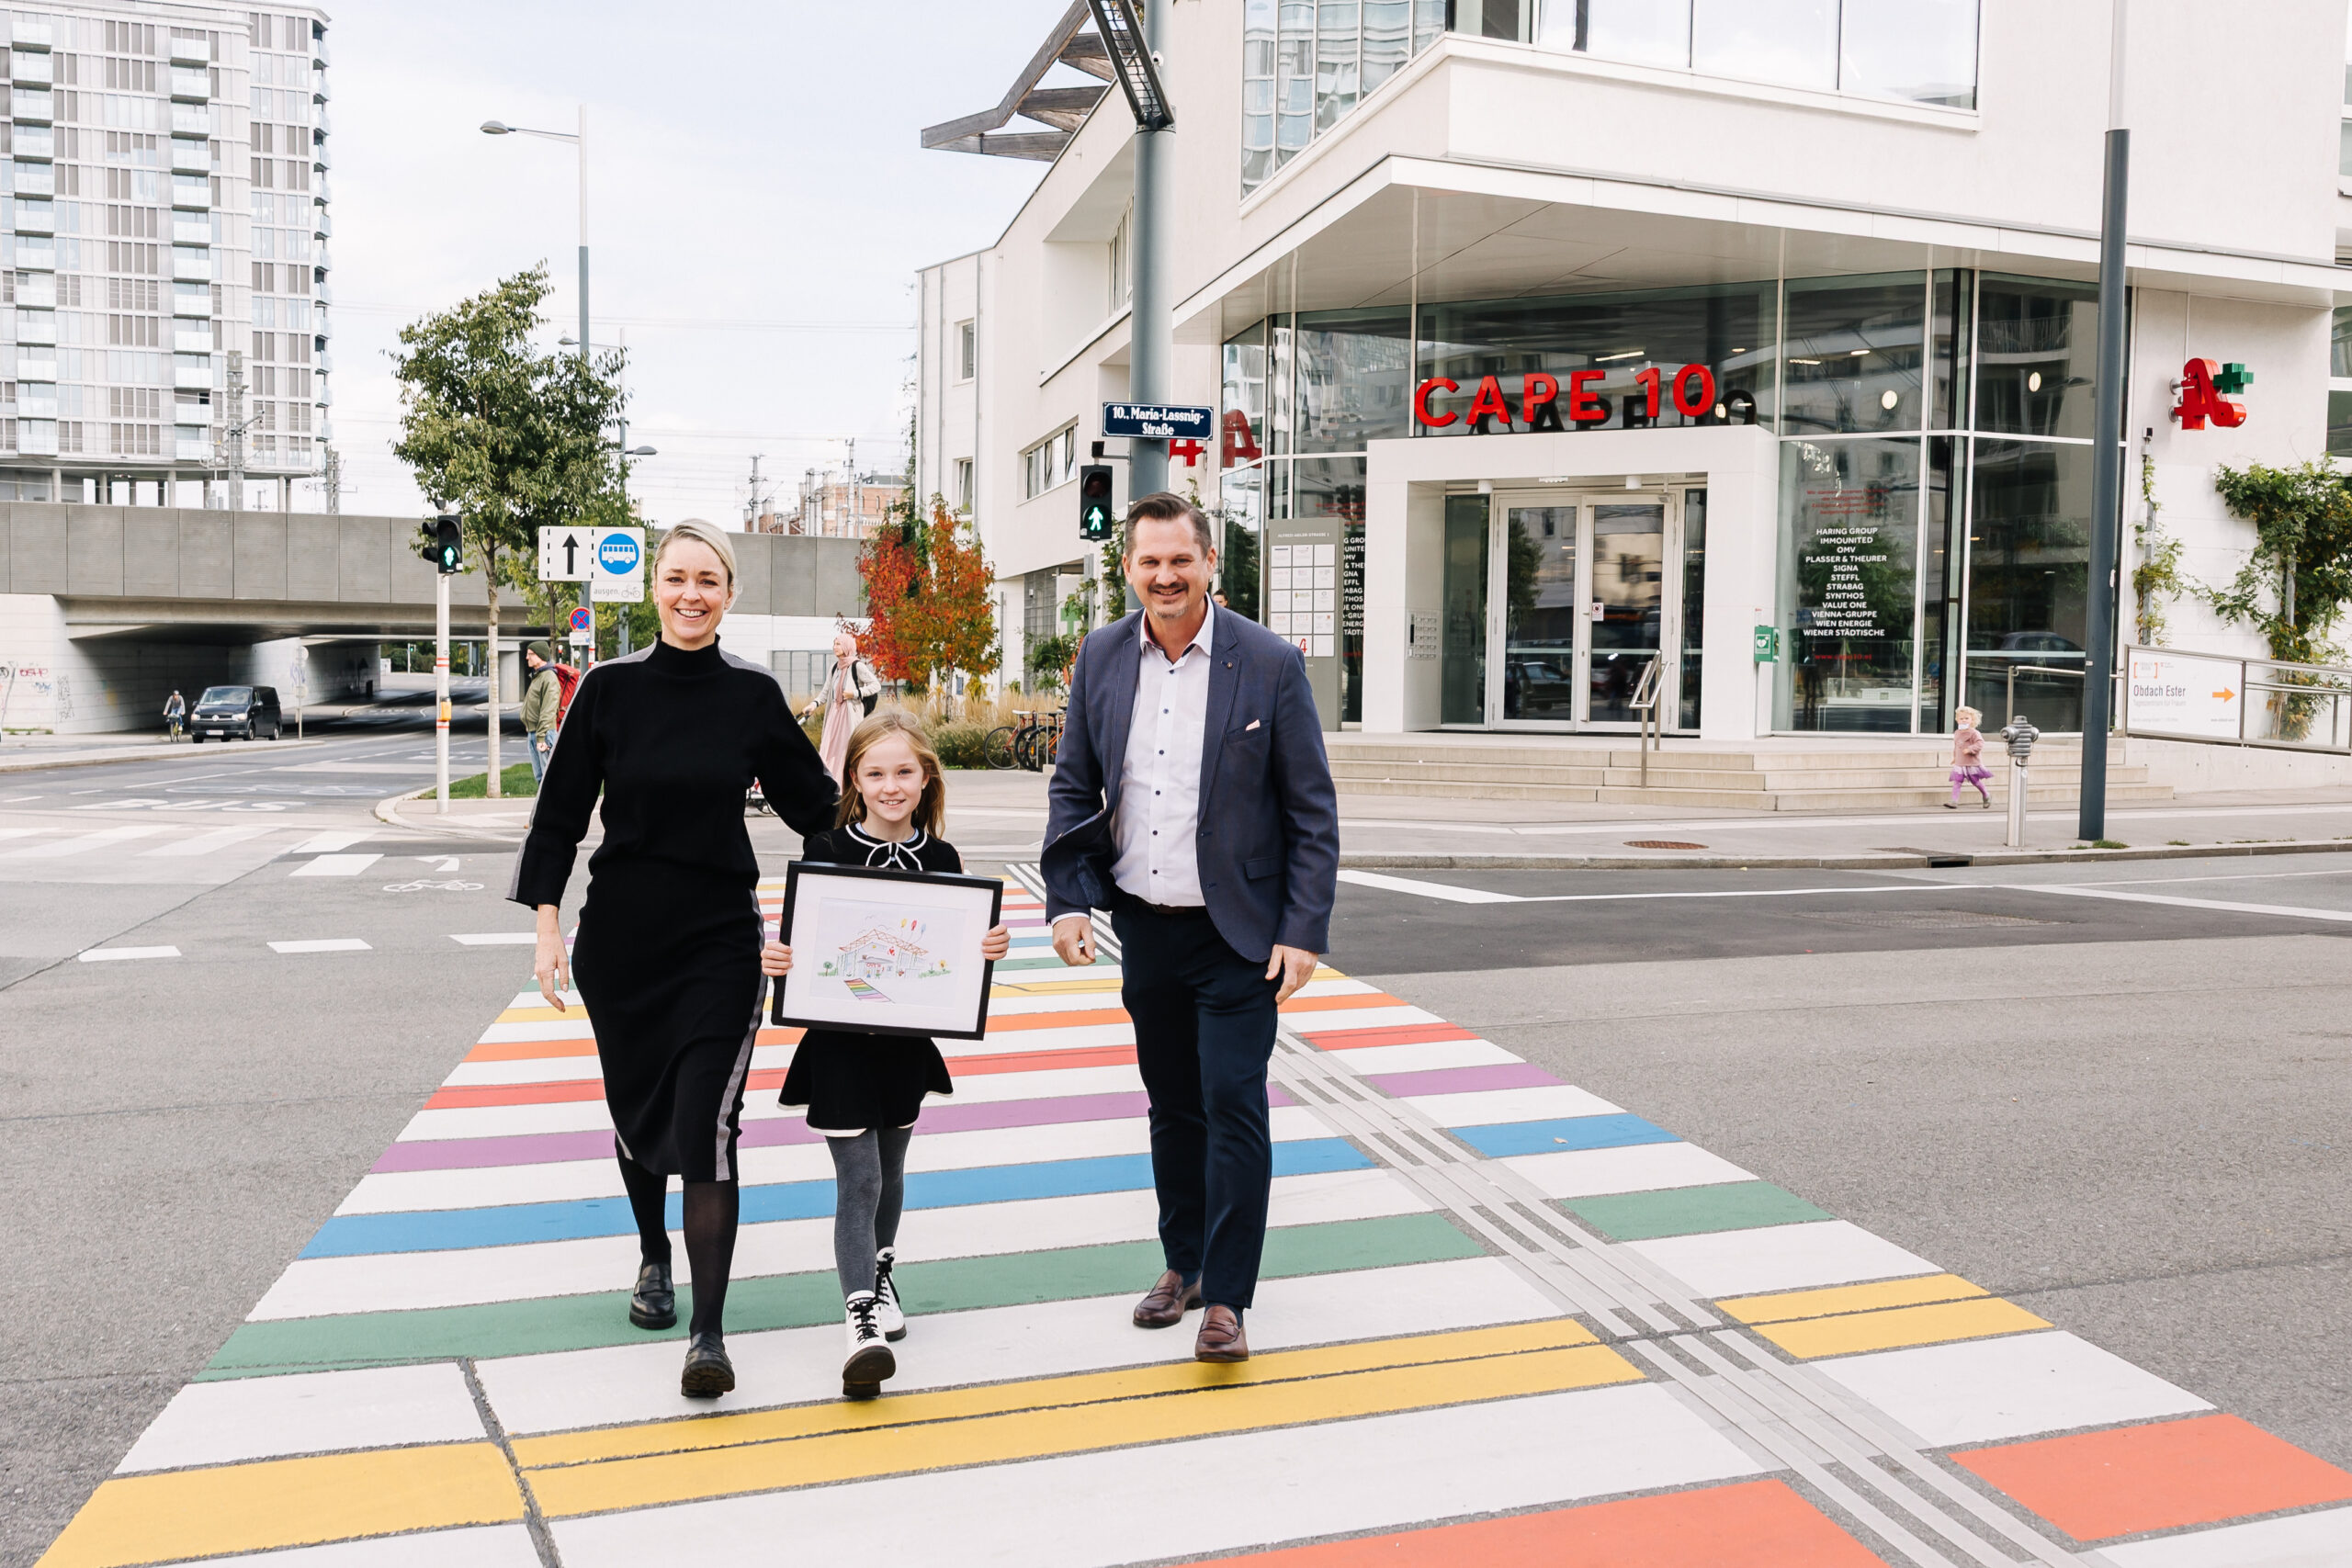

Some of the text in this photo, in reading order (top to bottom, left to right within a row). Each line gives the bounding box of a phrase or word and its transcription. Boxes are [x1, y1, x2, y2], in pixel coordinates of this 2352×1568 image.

[1414, 363, 1716, 427] CAPE 10
[1131, 407, 1204, 425] Maria-Lassnig-
[1142, 423, 1175, 435] Straße
[1835, 628, 1885, 637] STÄDTISCHE
[2133, 685, 2186, 697] Obdach Ester
[69, 798, 306, 812] BUS
